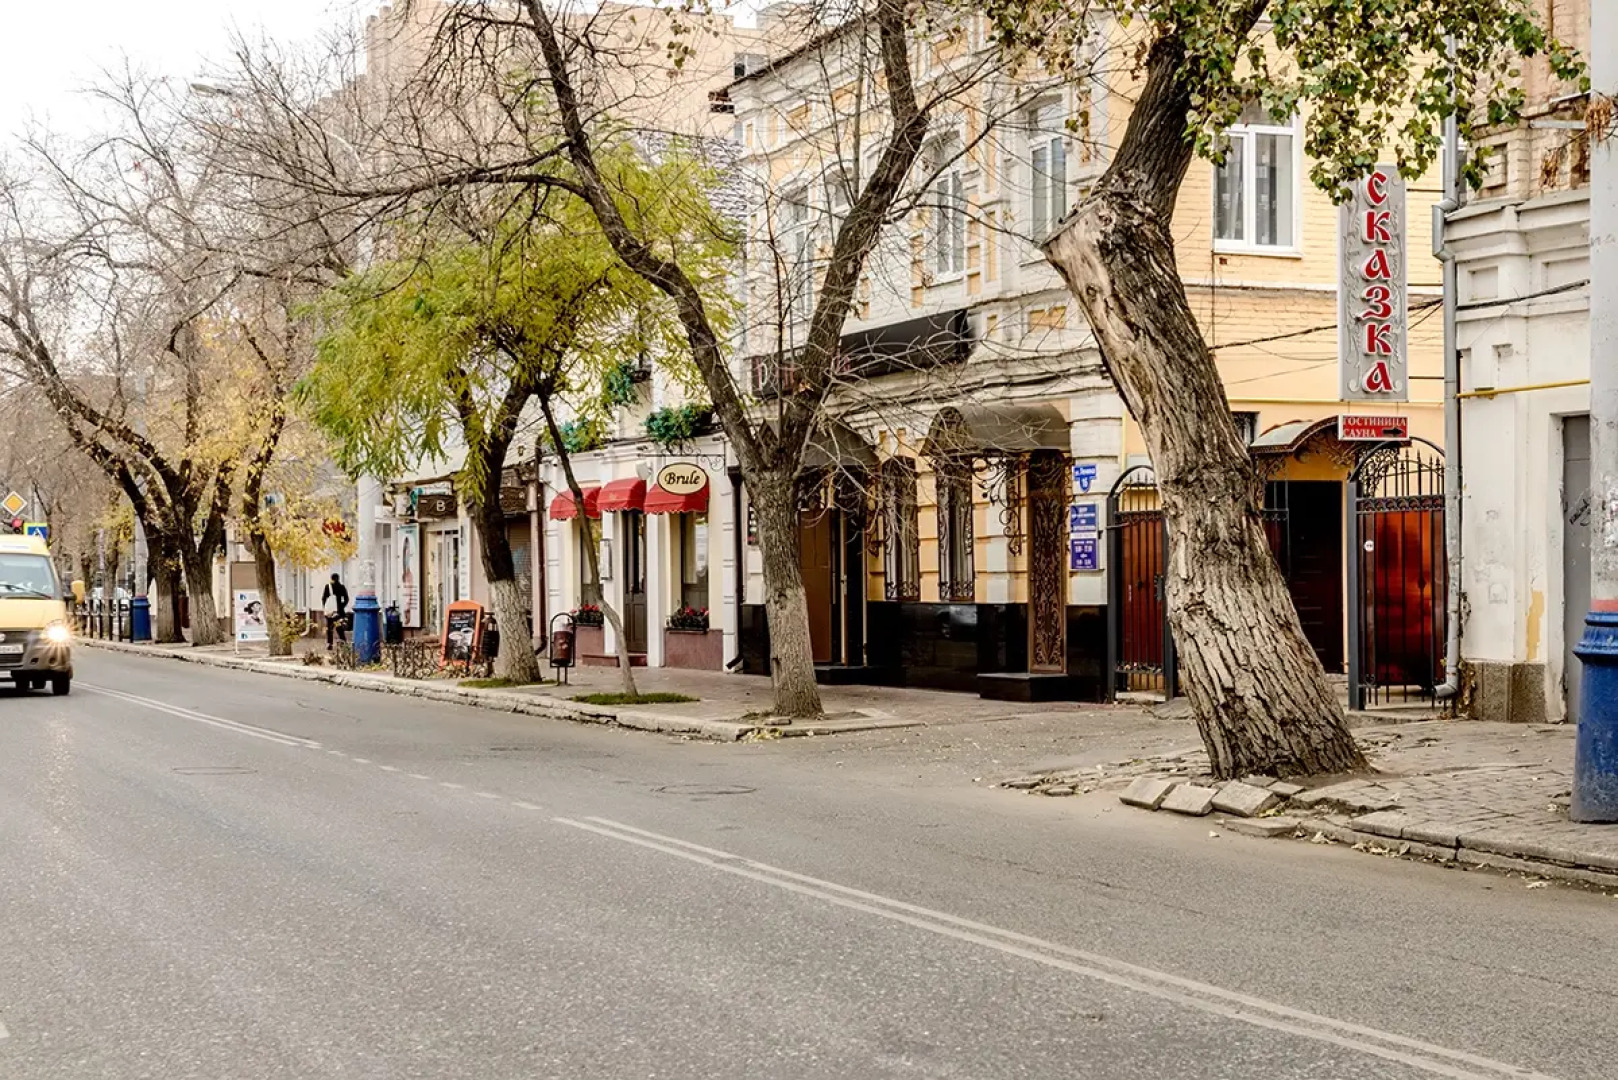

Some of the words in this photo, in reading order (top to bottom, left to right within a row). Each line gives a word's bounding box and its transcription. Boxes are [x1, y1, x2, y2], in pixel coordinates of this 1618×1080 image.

[1361, 171, 1392, 392] СКАЗКА
[1343, 417, 1407, 428] ГОСТИНИЦА
[1343, 428, 1377, 438] САУНА
[664, 470, 700, 485] Brule
